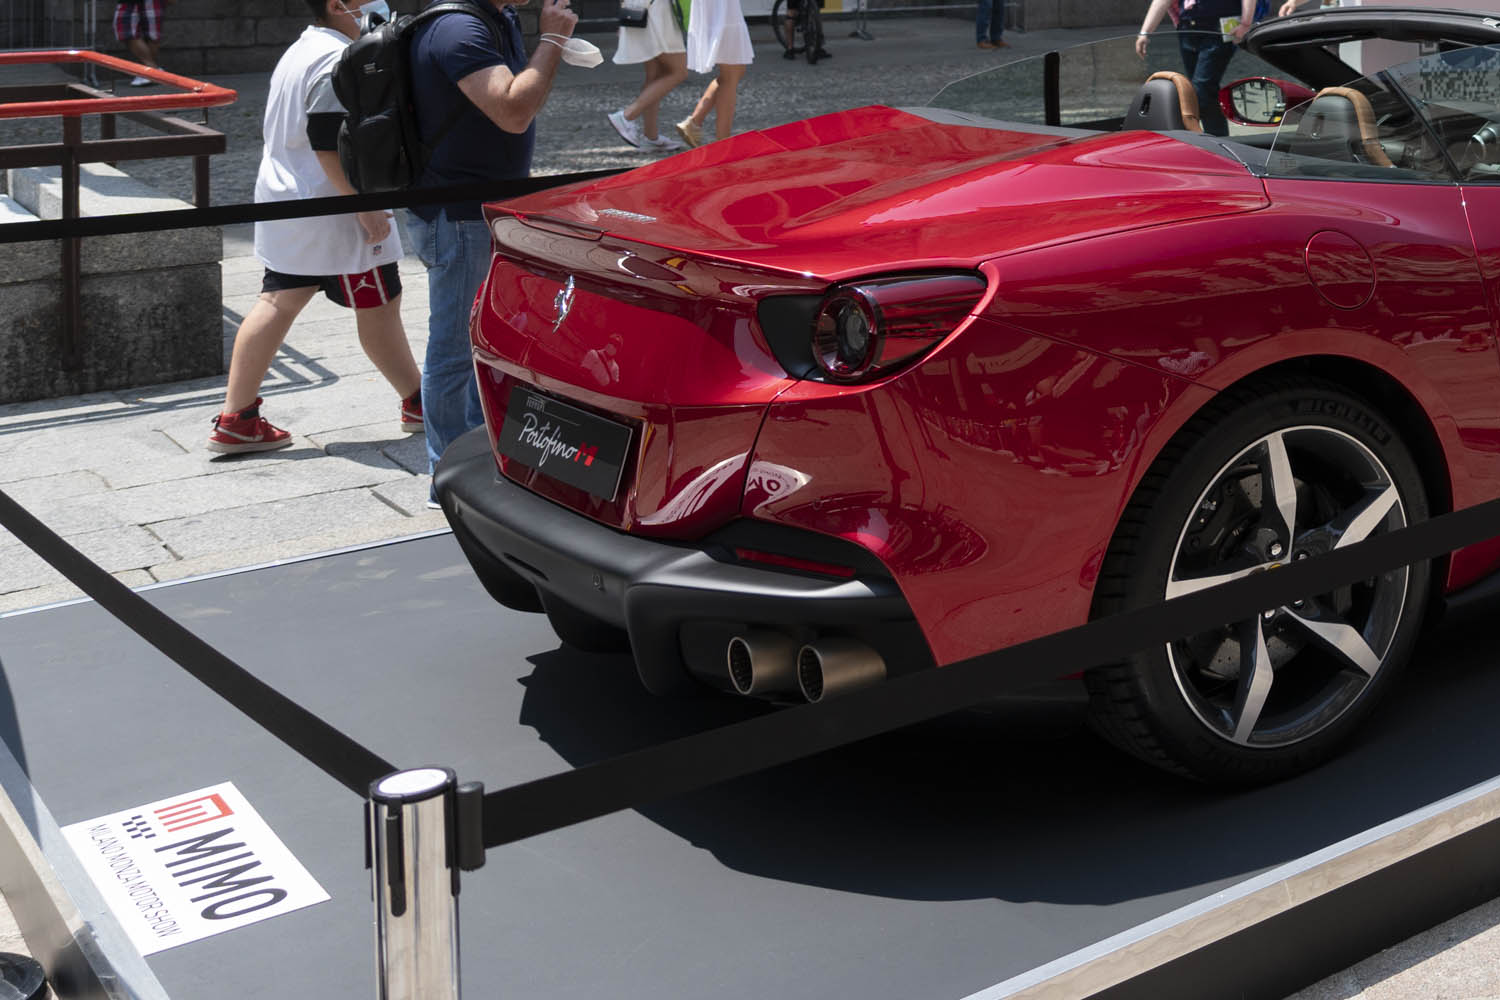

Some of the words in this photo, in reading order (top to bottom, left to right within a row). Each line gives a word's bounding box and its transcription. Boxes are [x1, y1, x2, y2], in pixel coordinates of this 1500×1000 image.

[88, 823, 124, 854] MILANO
[106, 852, 143, 887] MONZA
[153, 827, 288, 920] MIMO
[127, 880, 164, 912] MOTOR
[144, 909, 183, 938] SHOW
